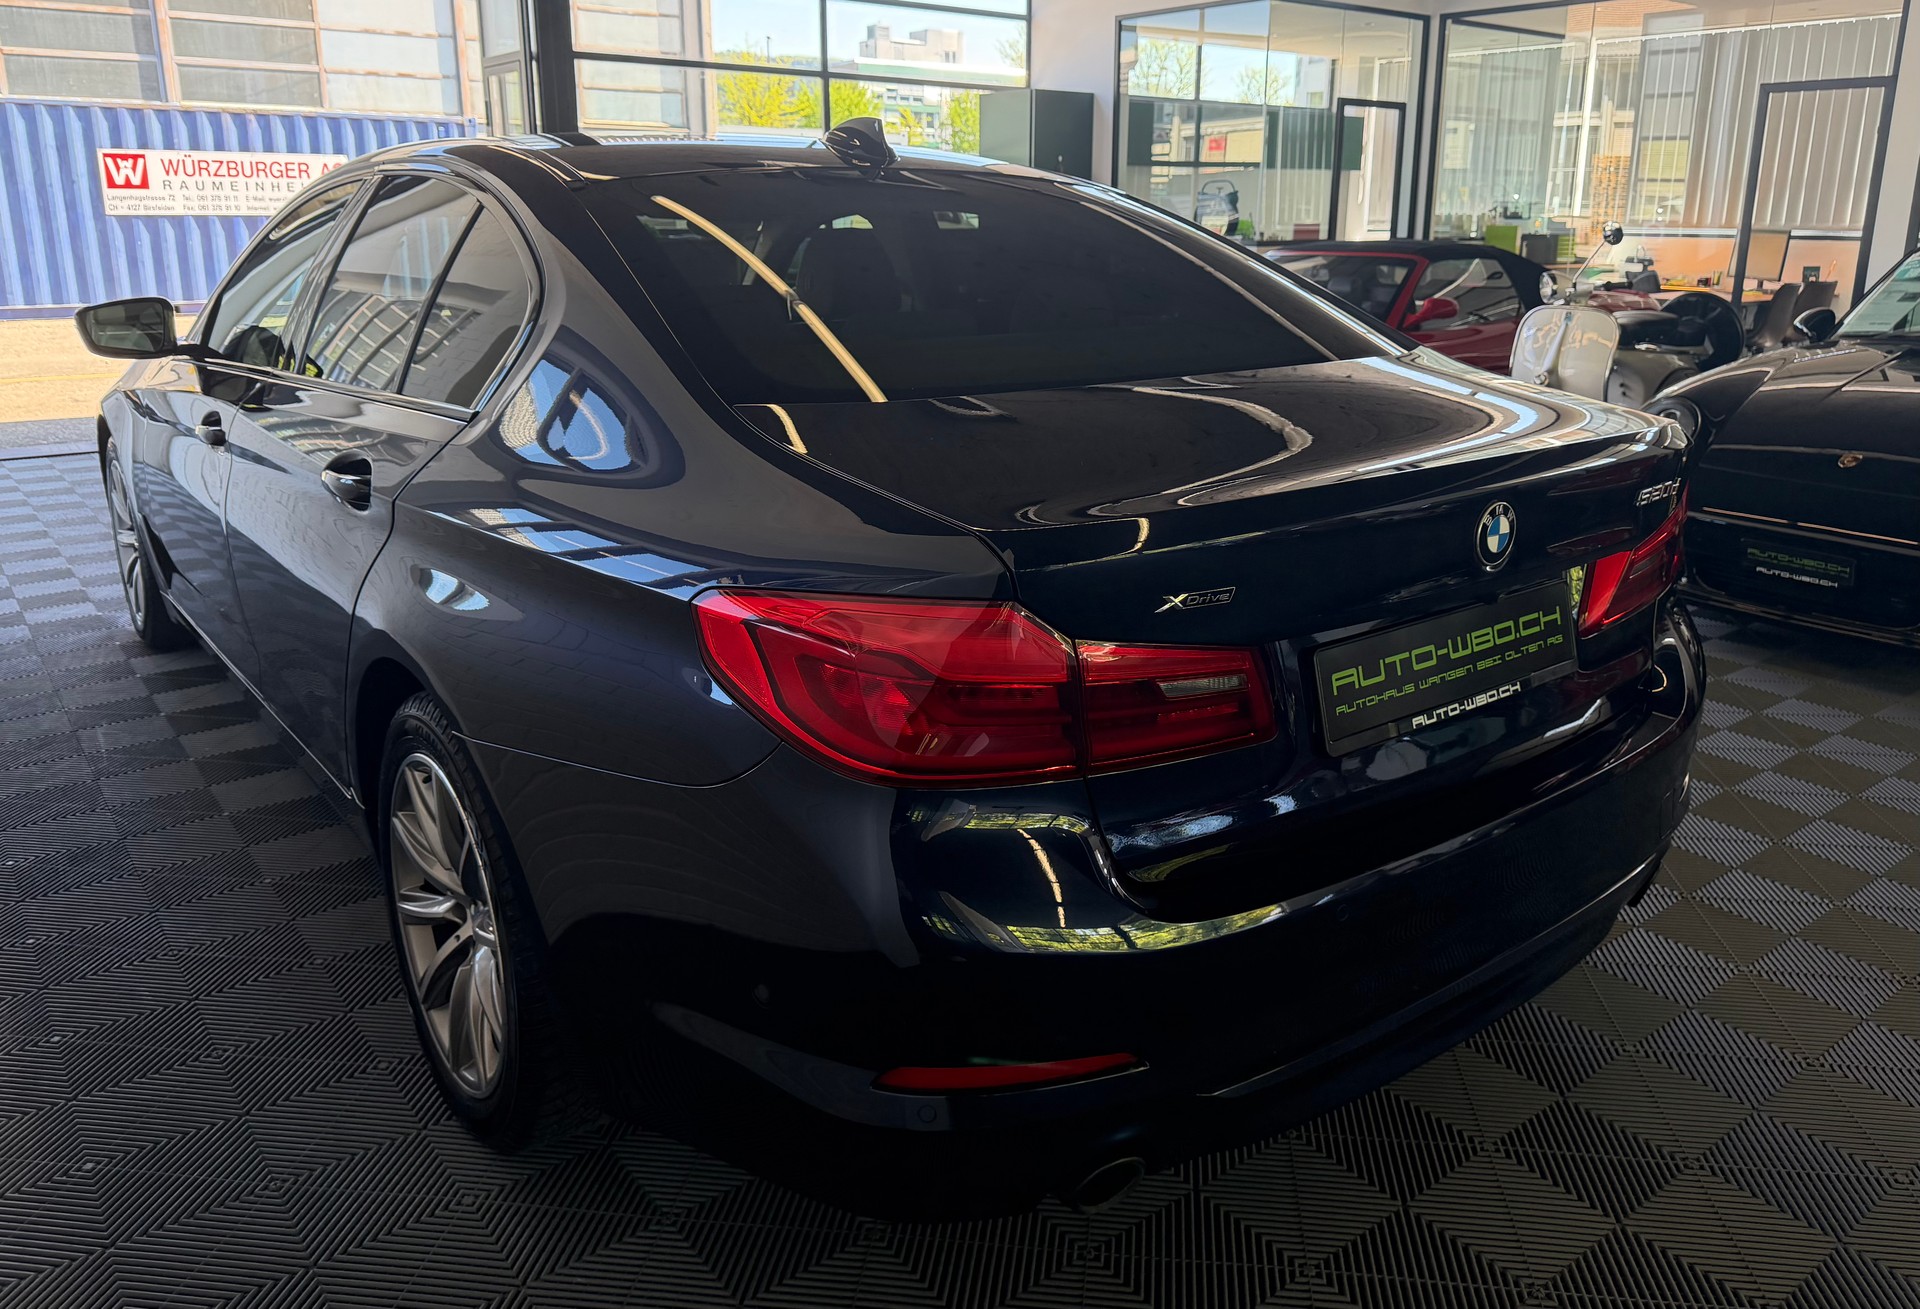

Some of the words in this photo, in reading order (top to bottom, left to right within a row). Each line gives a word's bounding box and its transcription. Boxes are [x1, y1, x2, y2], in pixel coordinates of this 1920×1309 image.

[160, 154, 311, 179] WÜRZBURGER
[1483, 504, 1514, 526] BMW
[1748, 548, 1850, 574] AUTO-WBO.CH
[1755, 566, 1838, 589] AUTO-WBO.CH
[1331, 606, 1562, 696] AUTO-WBO.CH
[1336, 683, 1416, 716] AUTOHAUS
[1419, 664, 1474, 689] WANGEN
[1477, 656, 1503, 671] BEI
[1505, 640, 1545, 664] OLTEN
[1547, 634, 1564, 648] AG
[1412, 681, 1522, 729] AUTO-WBO.CH
